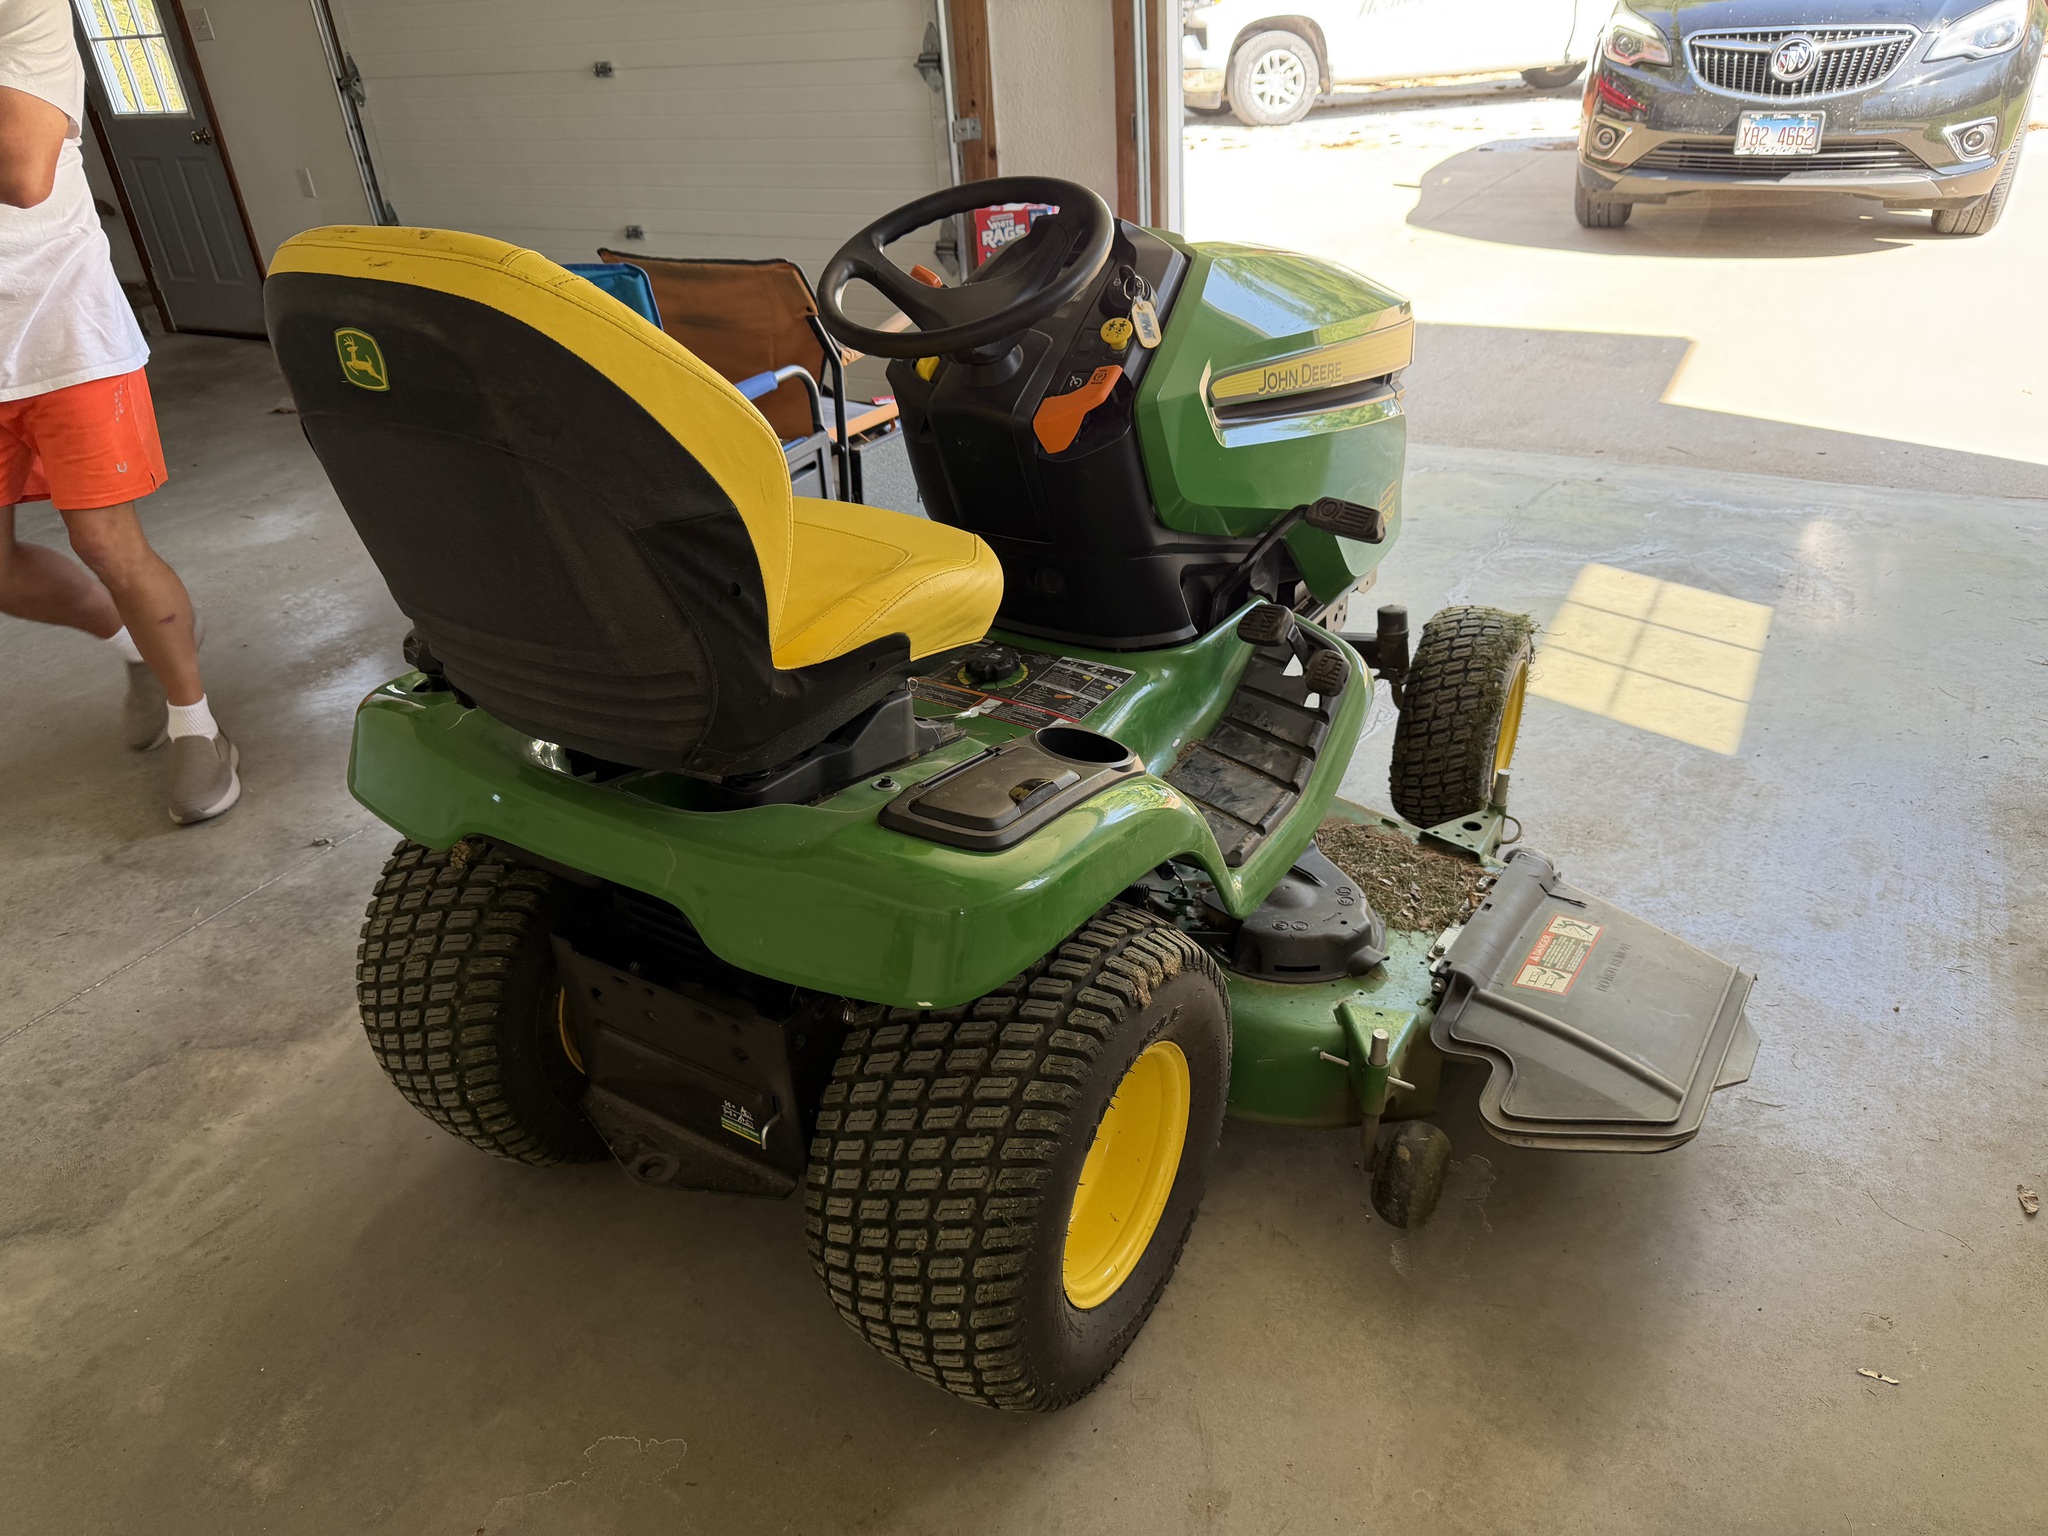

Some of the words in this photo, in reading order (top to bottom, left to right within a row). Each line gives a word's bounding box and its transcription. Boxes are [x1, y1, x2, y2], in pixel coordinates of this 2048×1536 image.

[1742, 126, 1770, 146] Y82
[1776, 126, 1816, 146] 4662
[981, 223, 1026, 249] RAGS
[986, 218, 1015, 230] WHITE
[1258, 369, 1298, 392] JOHN
[1301, 361, 1342, 385] DEERE
[1532, 934, 1551, 959] DANGER
